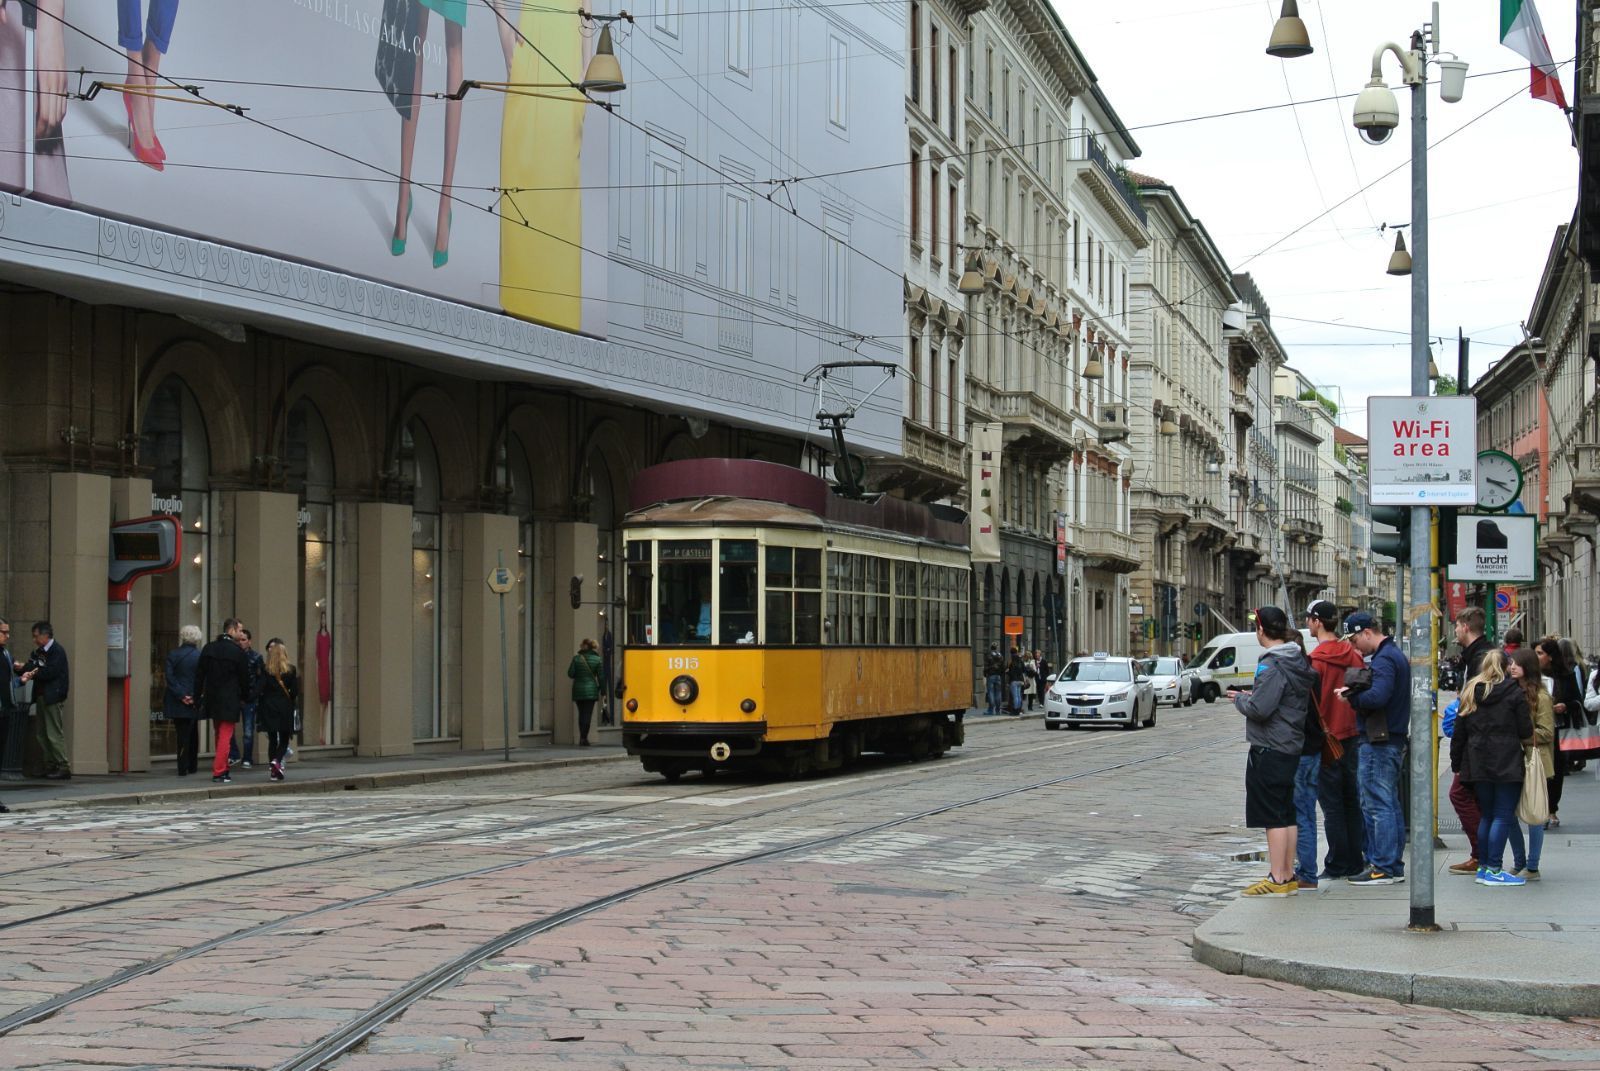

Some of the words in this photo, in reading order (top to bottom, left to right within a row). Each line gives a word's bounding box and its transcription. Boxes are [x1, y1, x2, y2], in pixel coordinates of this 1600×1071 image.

[294, 0, 442, 65] DELLASCALA.COM
[1392, 420, 1449, 438] Wi-Fi
[1393, 443, 1449, 456] area
[1476, 554, 1508, 564] furcht
[668, 657, 699, 670] 1915
